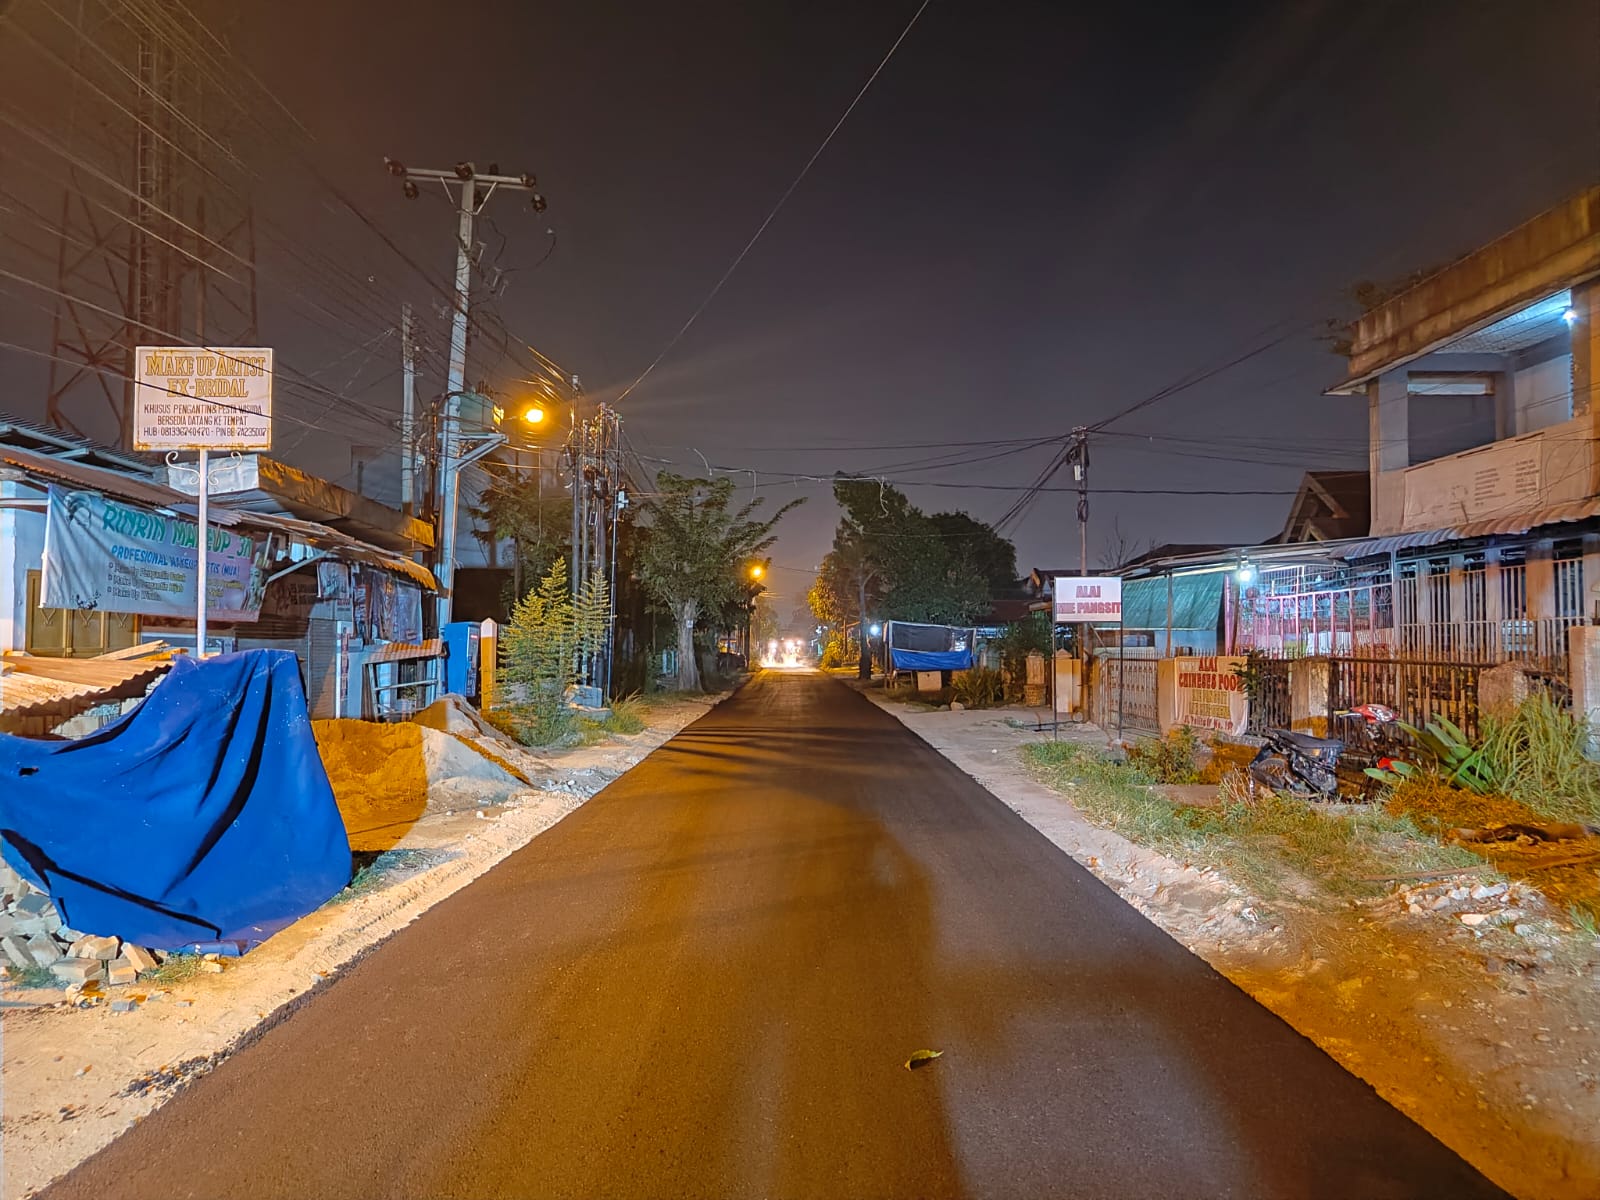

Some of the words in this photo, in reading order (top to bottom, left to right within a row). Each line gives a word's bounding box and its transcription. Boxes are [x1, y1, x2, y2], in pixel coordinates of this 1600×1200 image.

[145, 356, 194, 376] MAKE
[167, 378, 248, 397] EX-BRIDAL
[144, 404, 171, 414] KHUSUS
[218, 405, 237, 415] PESTA
[157, 416, 186, 425] BERSEDIA
[187, 416, 212, 426] DATANG
[213, 416, 222, 426] KE
[224, 416, 248, 426] TEMPAT
[102, 504, 166, 543] RINRIN
[1077, 602, 1120, 613] PANGSIT
[1199, 657, 1217, 672] ALAI
